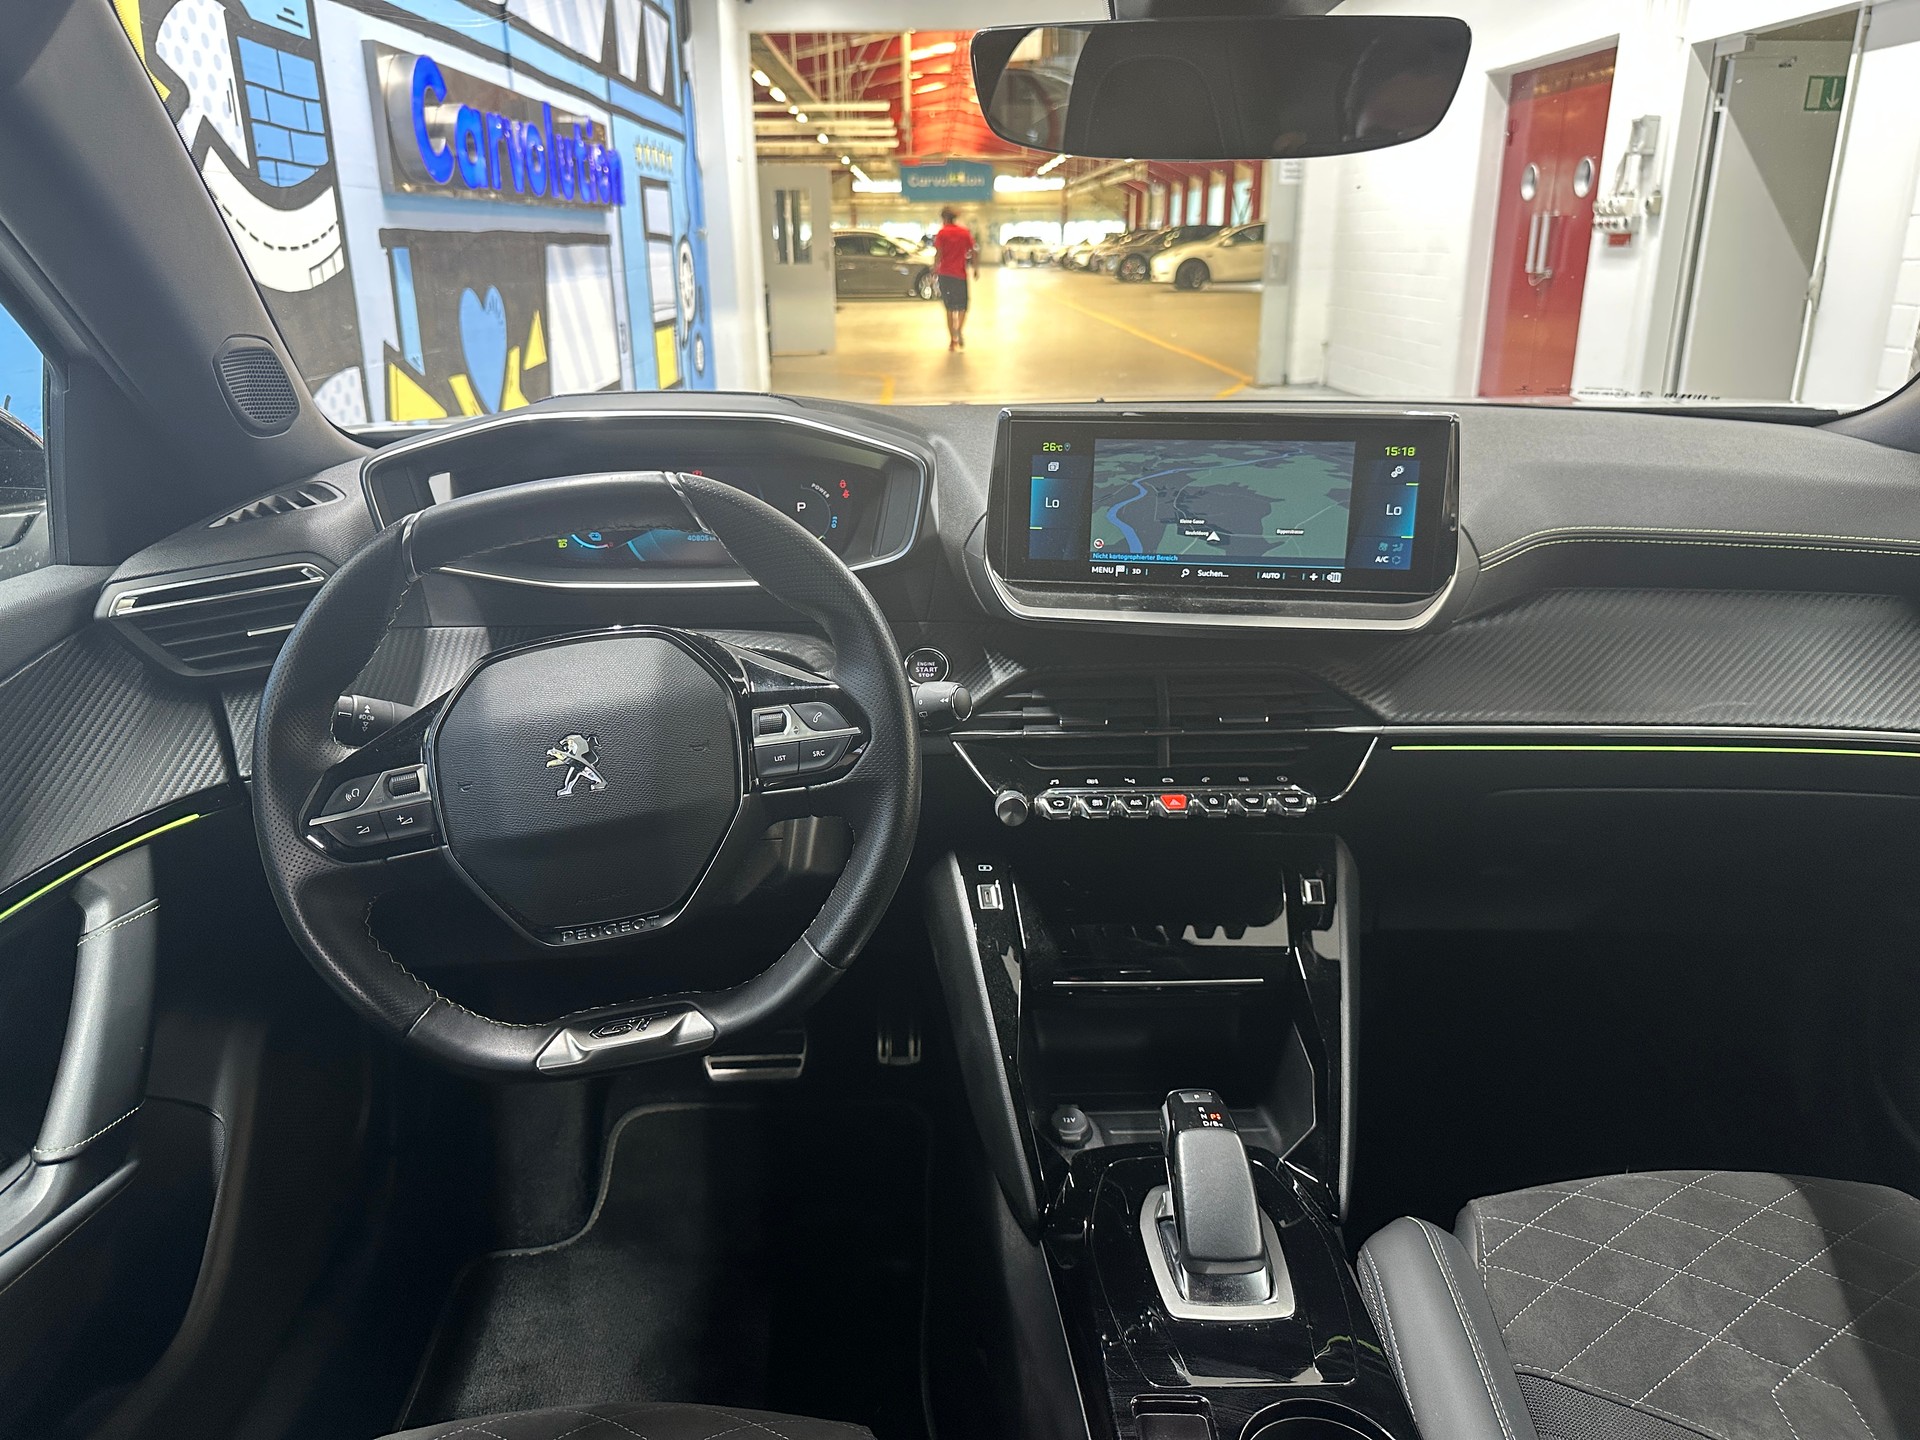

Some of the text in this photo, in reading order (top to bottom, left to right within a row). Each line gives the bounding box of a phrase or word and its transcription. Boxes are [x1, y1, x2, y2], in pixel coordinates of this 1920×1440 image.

[411, 54, 626, 206] Carvolution
[1384, 446, 1416, 456] 15:18
[811, 483, 830, 498] POWER
[797, 502, 806, 512] P
[1045, 496, 1060, 508] Lo
[1385, 503, 1402, 515] Lo
[1374, 555, 1390, 564] A/C
[1091, 566, 1114, 574] MENU
[1197, 569, 1229, 577] Suchen...
[1261, 572, 1281, 580] AUTO
[812, 749, 826, 758] SRC
[774, 755, 787, 763] LIST
[561, 914, 660, 942] PEUGEOT
